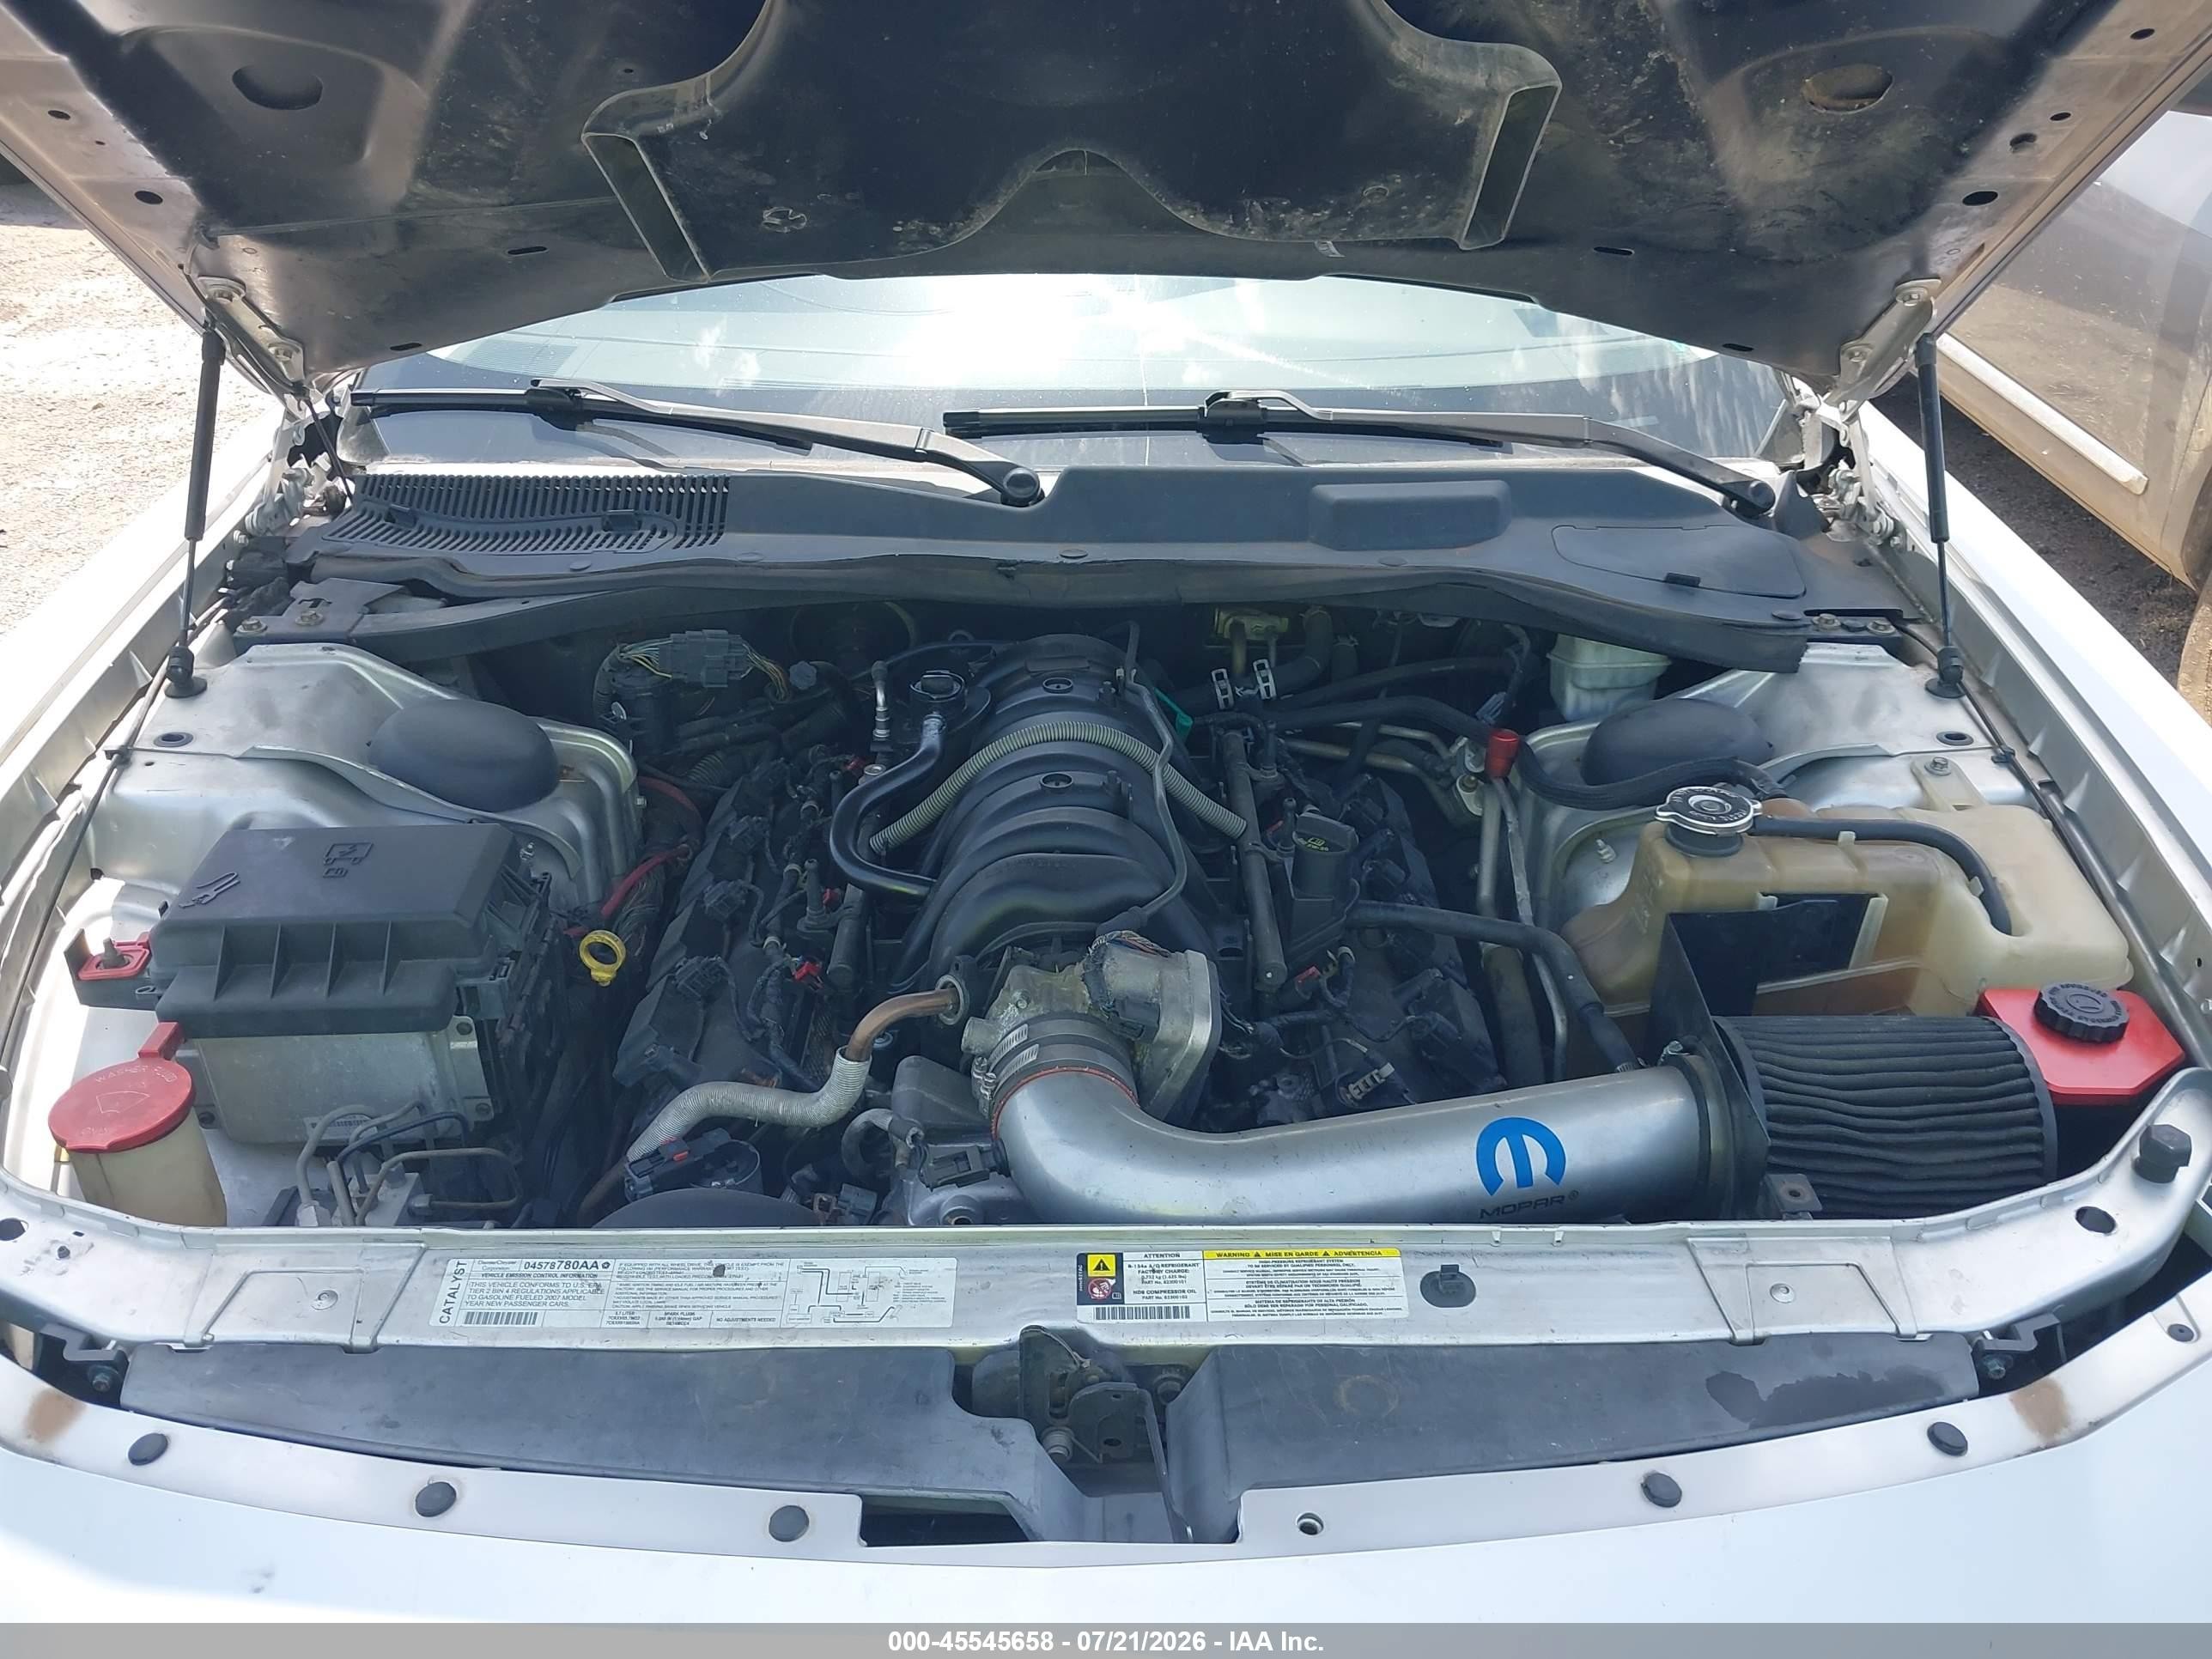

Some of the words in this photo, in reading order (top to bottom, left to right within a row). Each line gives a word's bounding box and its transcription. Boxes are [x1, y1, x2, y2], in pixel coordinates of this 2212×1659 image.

[1479, 1194, 1565, 1219] MOPAR
[524, 1260, 599, 1270] 04578780AA
[439, 1261, 468, 1324] CATALYST
